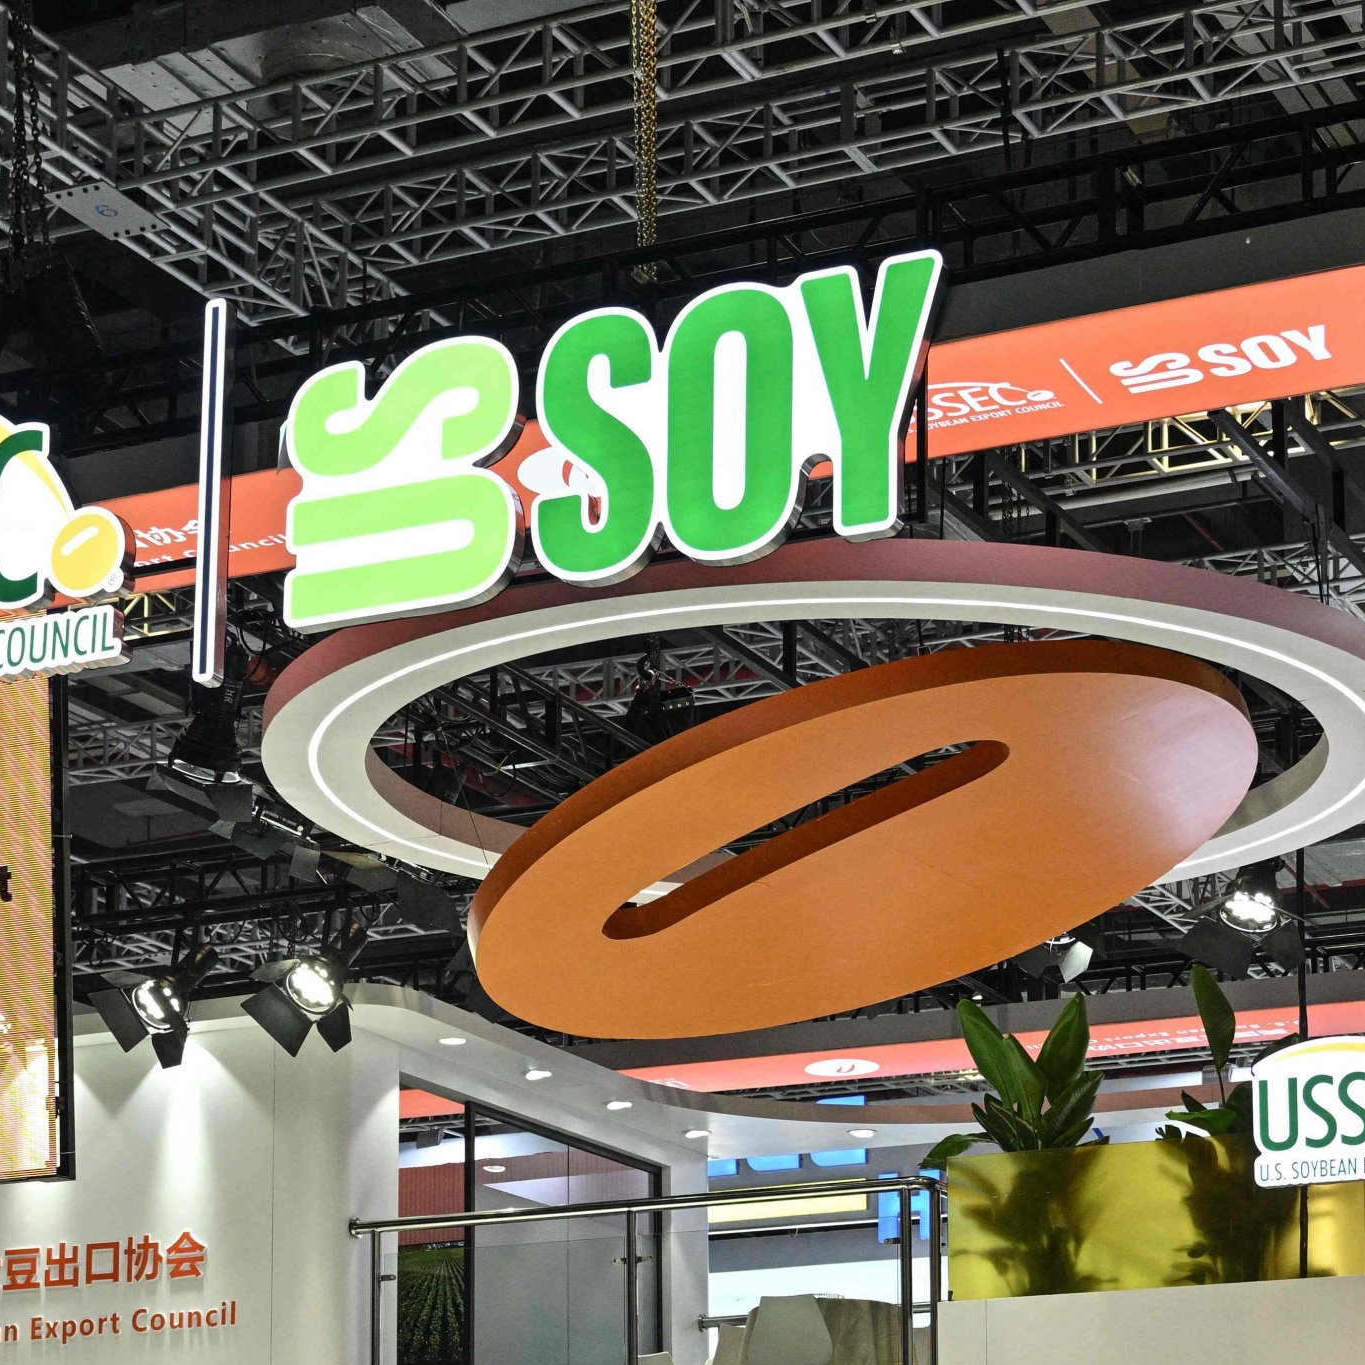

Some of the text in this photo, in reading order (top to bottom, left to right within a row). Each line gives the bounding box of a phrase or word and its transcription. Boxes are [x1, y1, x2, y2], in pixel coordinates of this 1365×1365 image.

[1200, 324, 1333, 378] SOY
[535, 255, 938, 575] SOY
[909, 381, 1029, 424] SEC
[971, 408, 1013, 424] EXPORT
[1015, 401, 1066, 416] COUNCIL
[1259, 1162, 1287, 1182] U.S.
[1291, 1158, 1357, 1179] SOYBEAN
[29, 1311, 122, 1346] Export
[131, 1301, 238, 1334] Council
